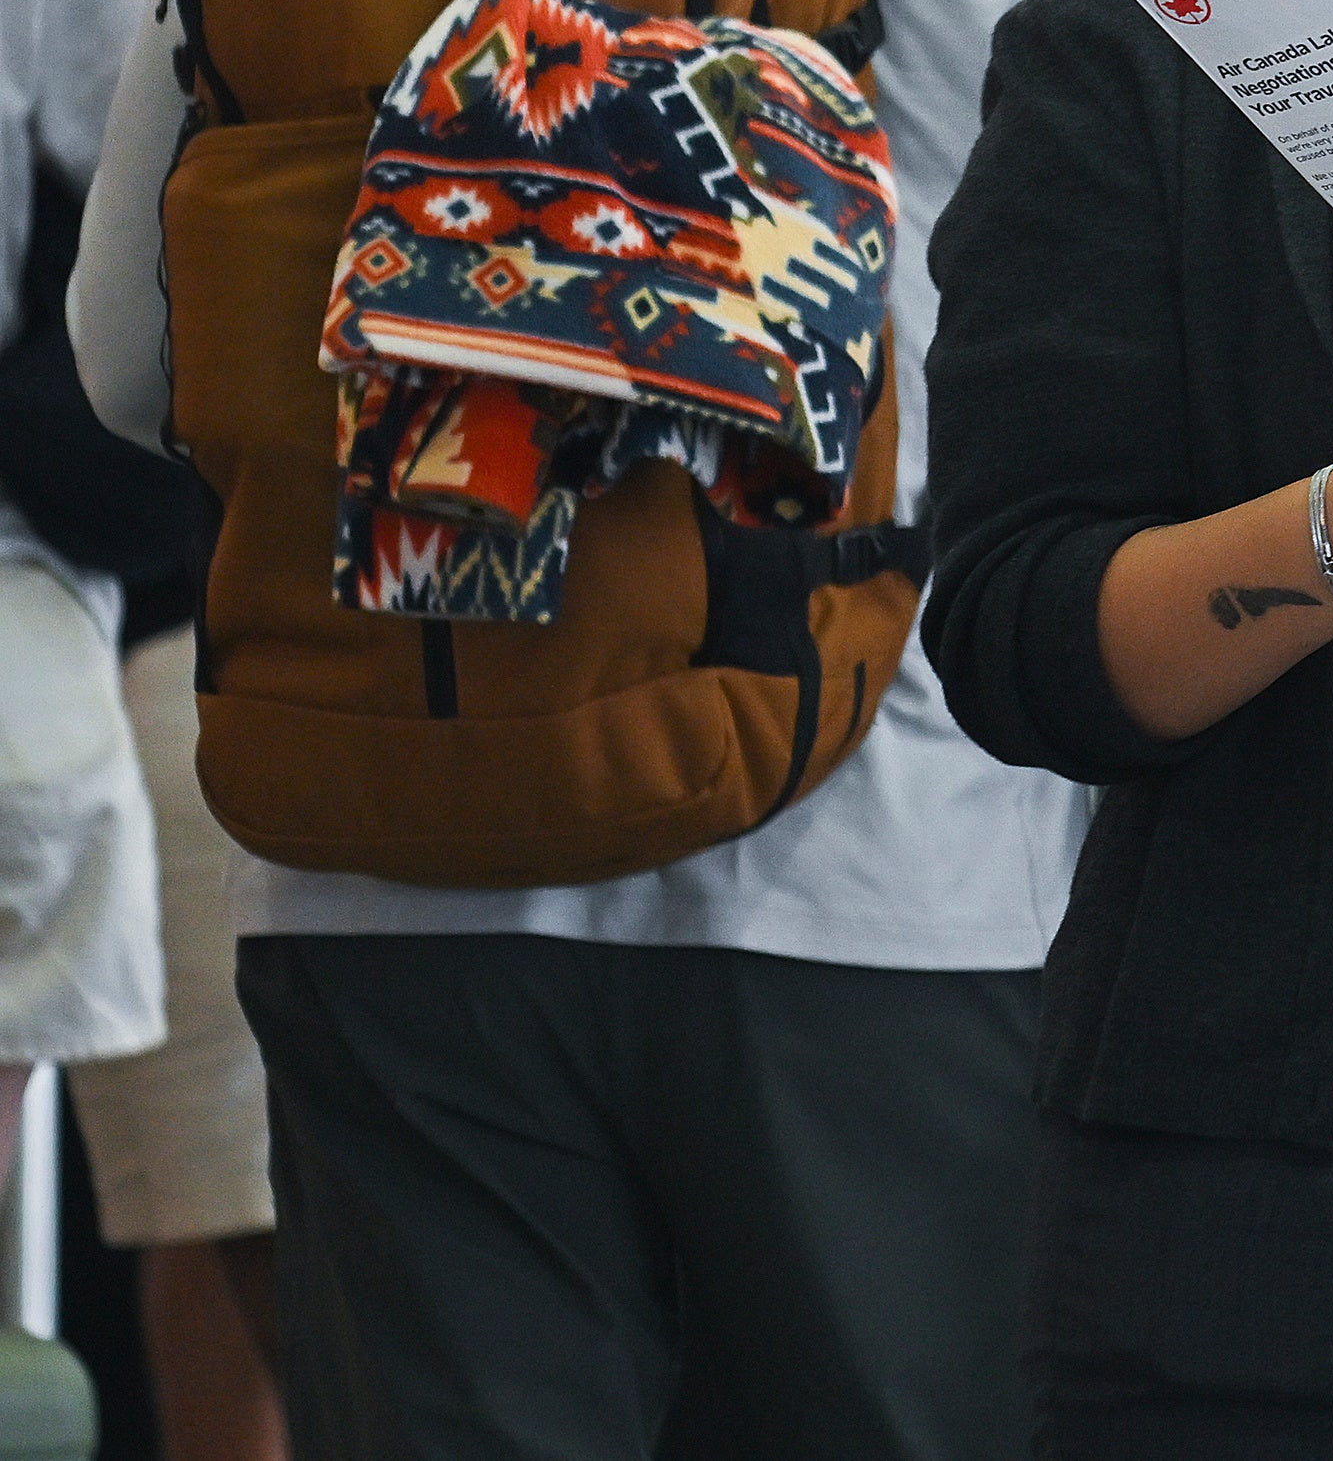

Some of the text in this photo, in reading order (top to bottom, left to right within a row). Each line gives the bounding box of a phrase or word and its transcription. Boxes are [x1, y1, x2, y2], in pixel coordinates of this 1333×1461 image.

[1216, 61, 1244, 79] Air
[1242, 43, 1312, 72] Canada
[1248, 98, 1294, 118] Your
[1277, 134, 1293, 144] On
[1291, 126, 1320, 141] behalf
[1320, 123, 1330, 133] of
[1286, 142, 1313, 154] we're
[1311, 136, 1332, 147] very
[1296, 149, 1327, 163] caused
[1311, 172, 1328, 182] We
